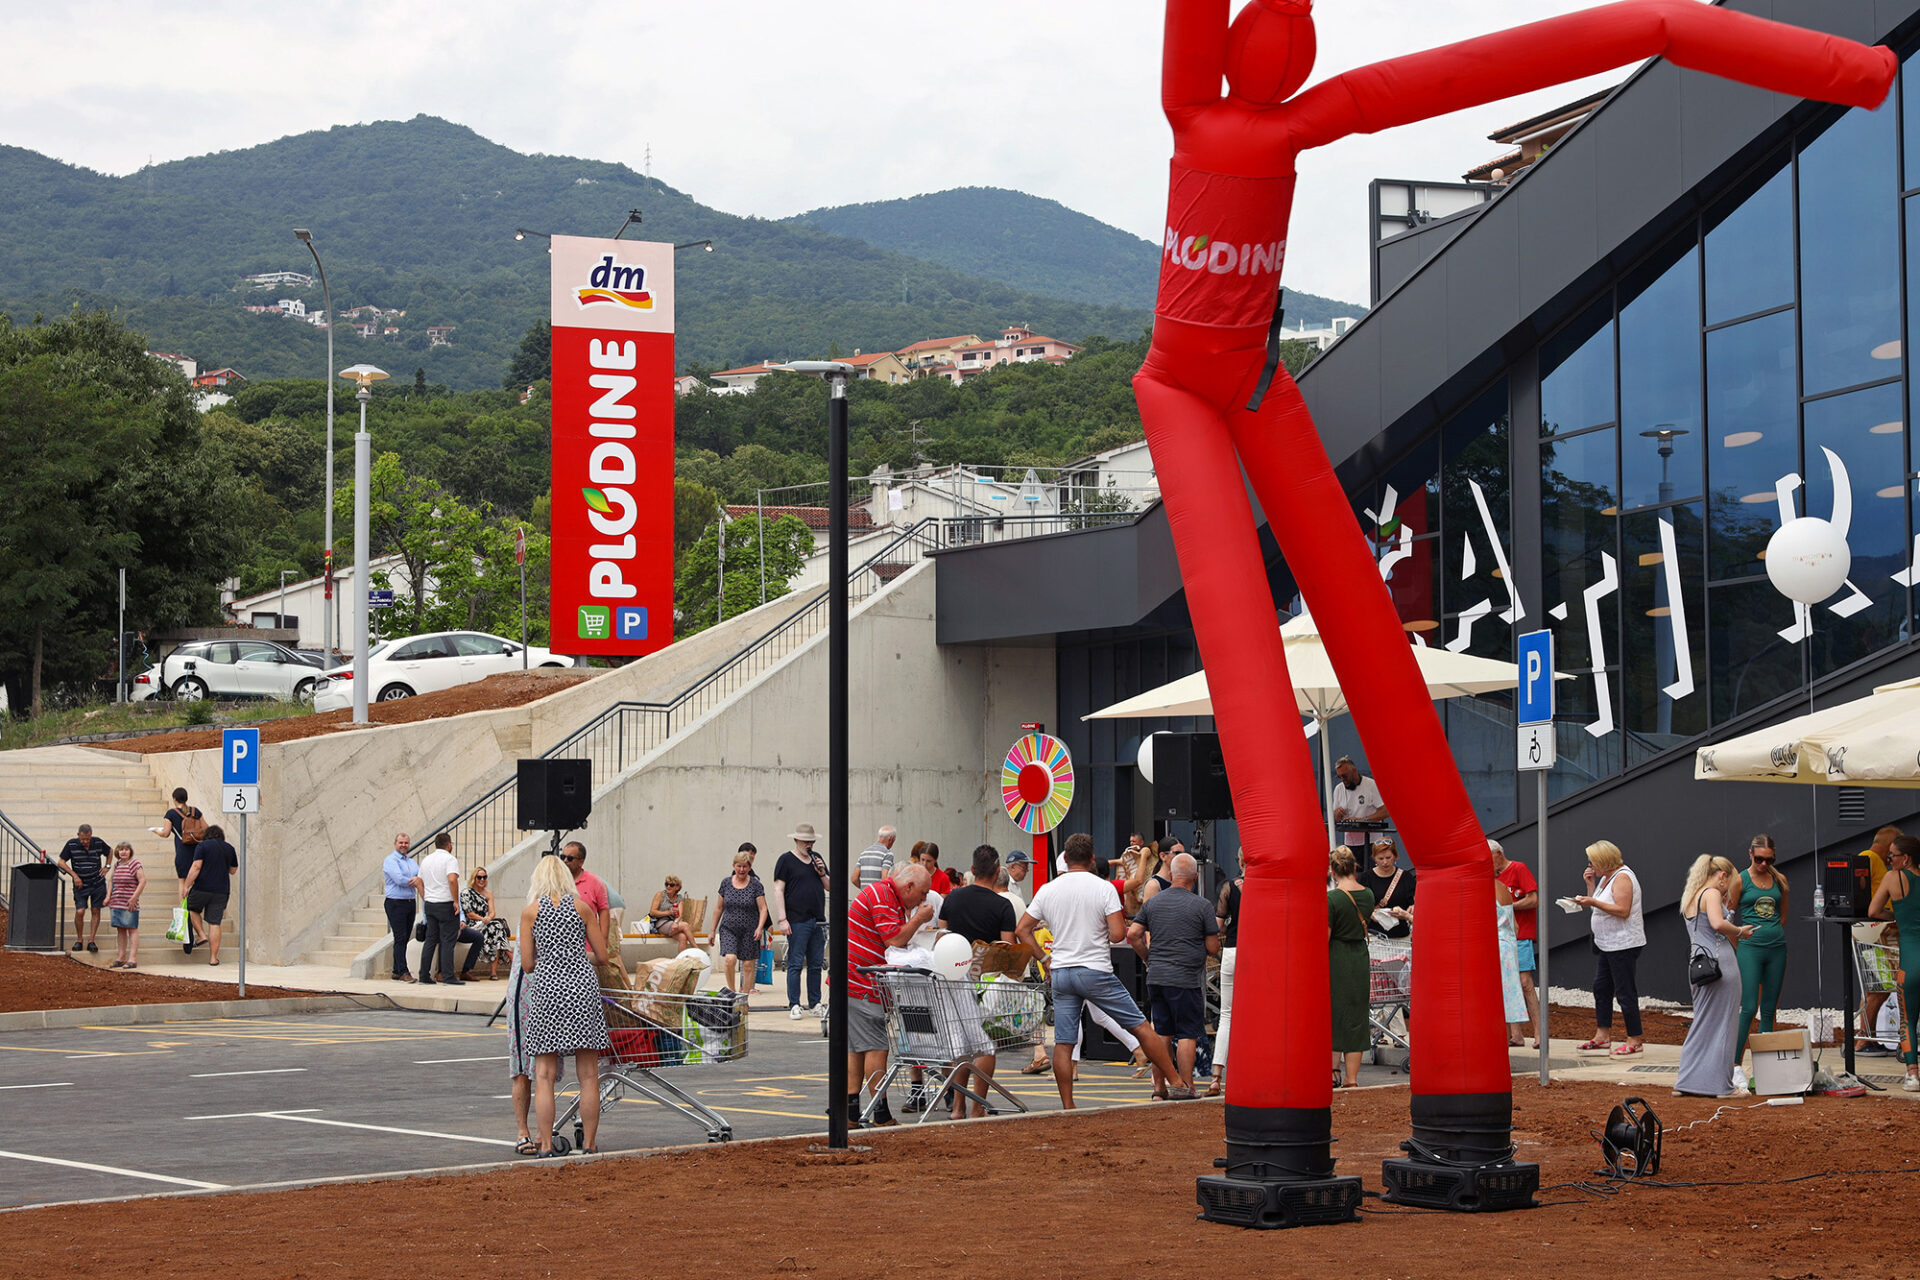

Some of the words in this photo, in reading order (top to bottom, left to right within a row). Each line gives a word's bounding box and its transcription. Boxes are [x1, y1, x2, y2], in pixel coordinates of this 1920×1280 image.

[590, 256, 645, 291] dm
[588, 338, 638, 598] PLODINE
[624, 612, 641, 635] P
[1527, 650, 1541, 705] P
[232, 739, 248, 773] P
